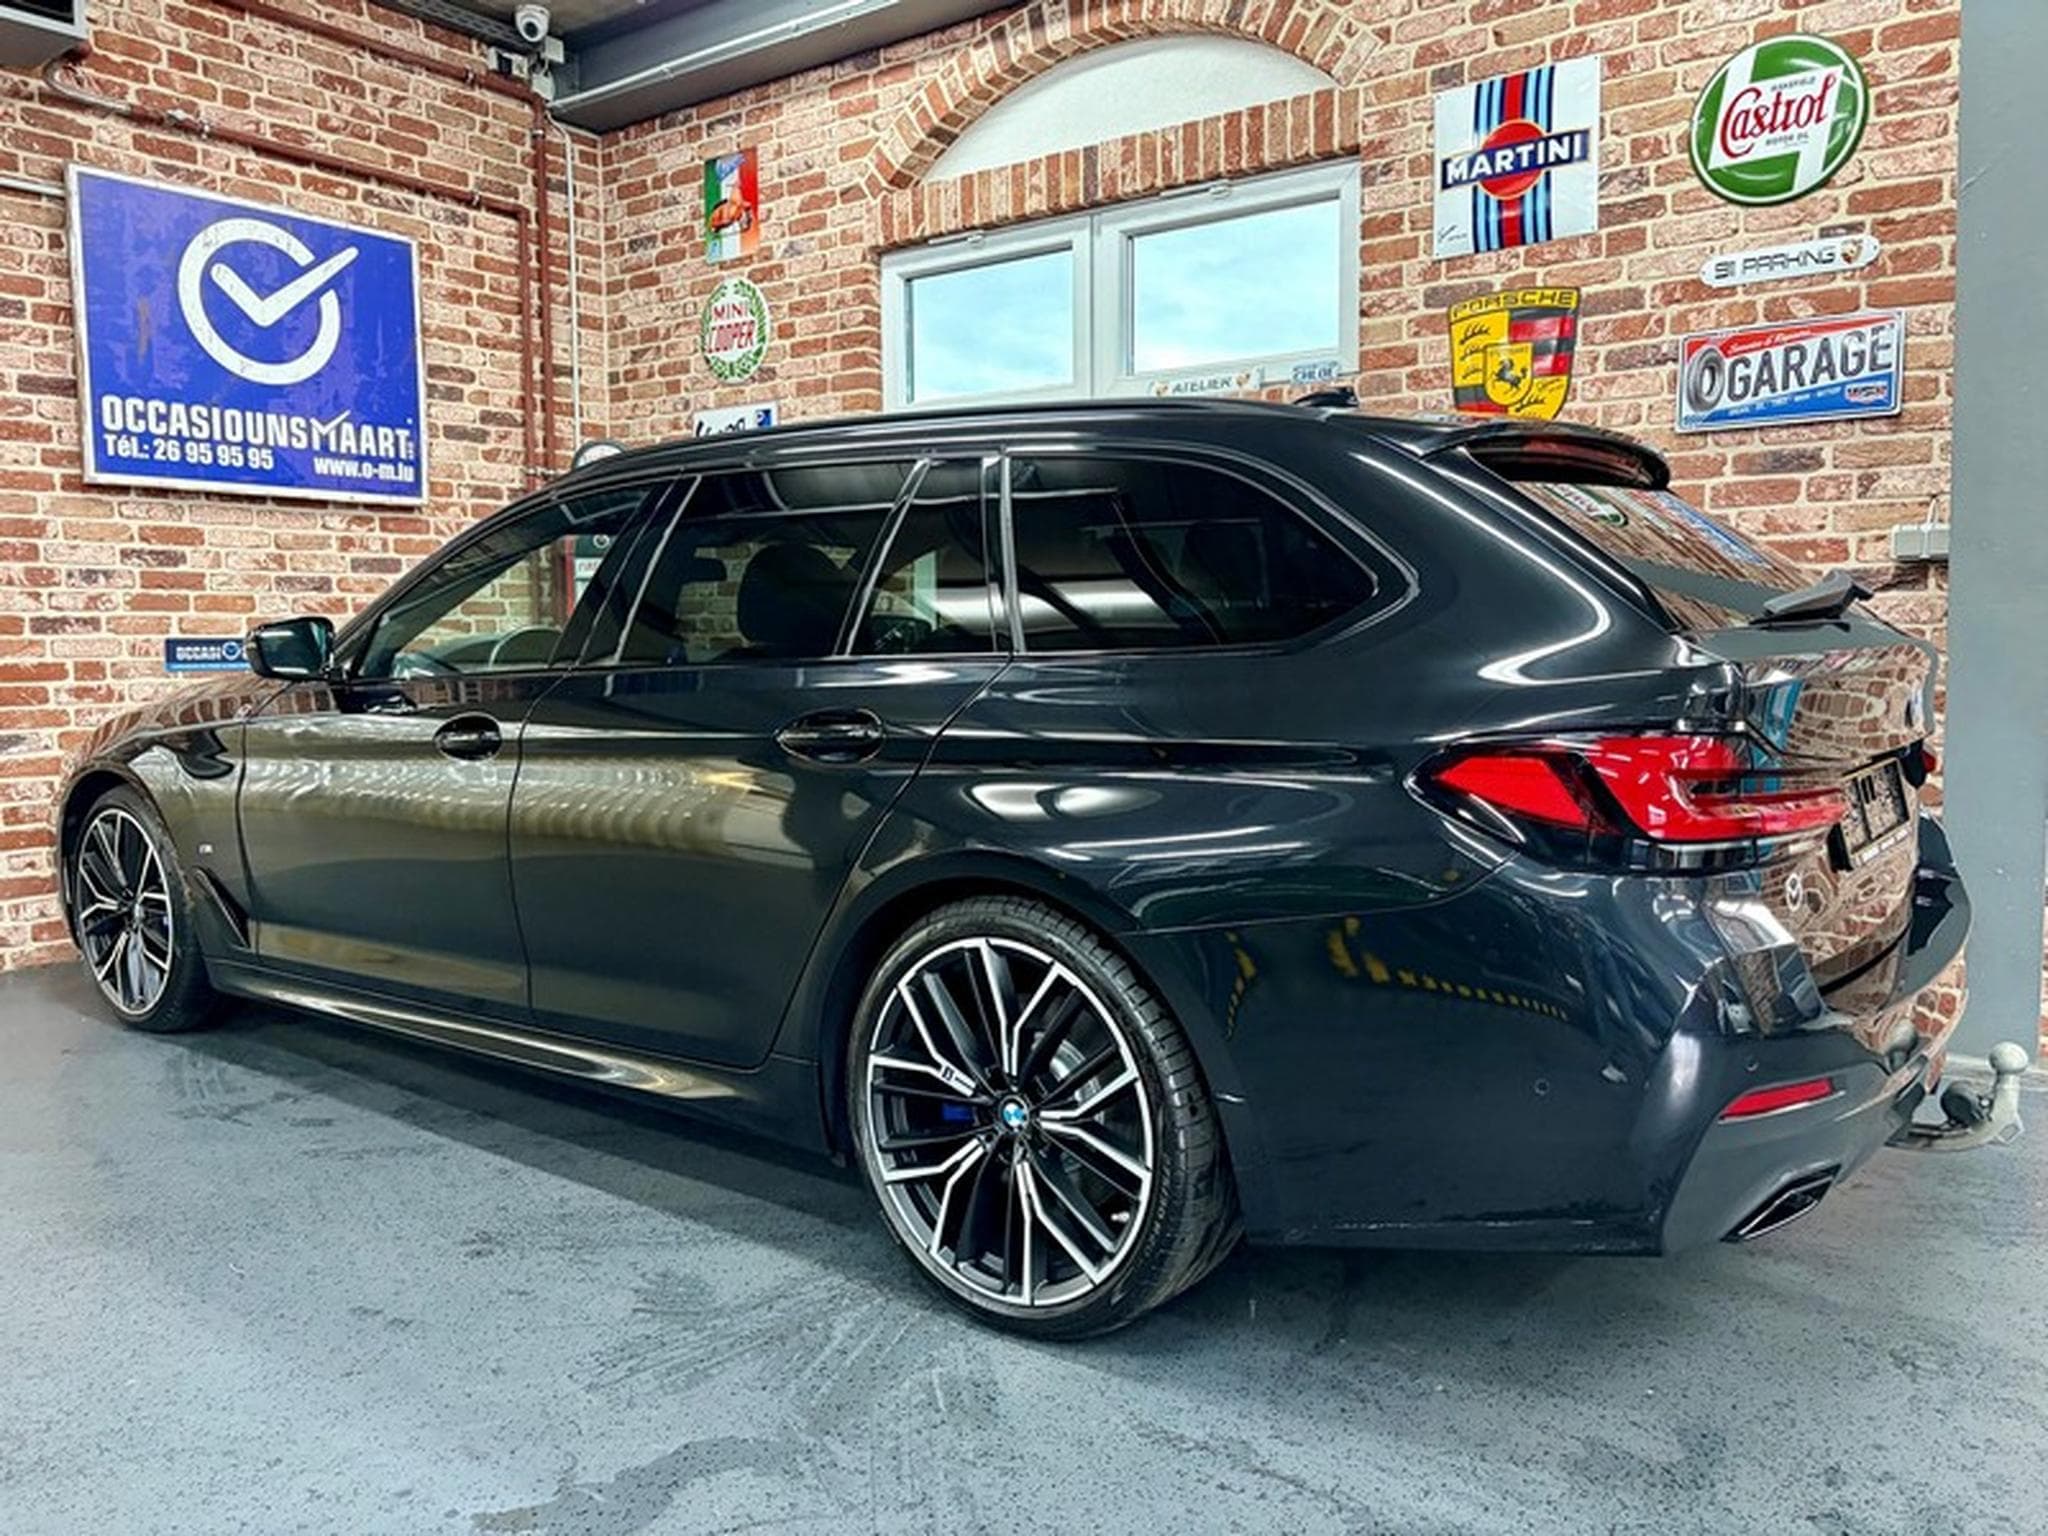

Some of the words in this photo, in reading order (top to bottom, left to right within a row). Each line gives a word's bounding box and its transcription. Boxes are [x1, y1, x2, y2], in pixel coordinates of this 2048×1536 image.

[1720, 74, 1836, 159] Castrol
[1445, 133, 1583, 186] MARTINI
[1742, 245, 1836, 275] PARKING
[711, 301, 749, 321] MINI
[1452, 290, 1574, 318] PORSCHE
[708, 319, 756, 354] COOPER
[1726, 325, 1893, 402] GARAGE
[153, 438, 181, 462] 26
[184, 441, 214, 465] 95
[217, 444, 245, 468] 95
[247, 448, 275, 470] 95
[313, 456, 415, 483] www.o-m.lu
